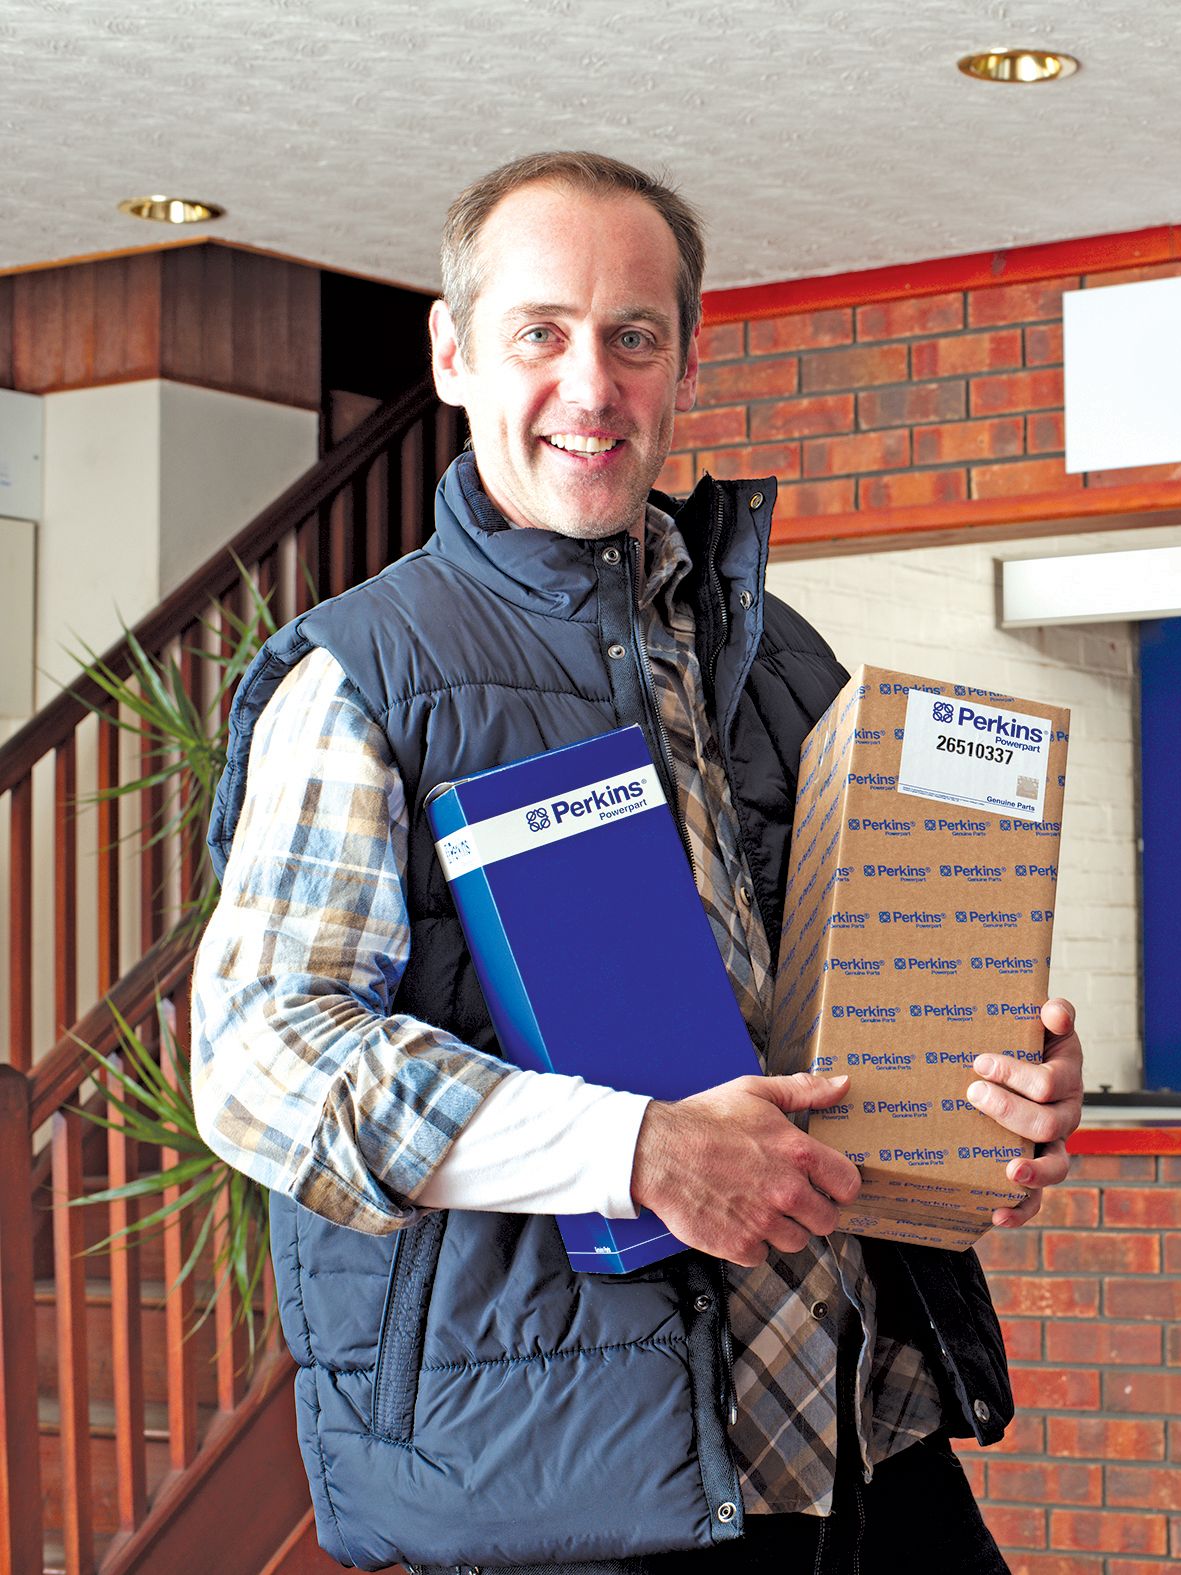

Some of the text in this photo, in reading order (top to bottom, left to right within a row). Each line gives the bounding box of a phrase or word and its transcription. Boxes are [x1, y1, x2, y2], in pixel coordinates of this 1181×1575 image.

[958, 706, 1043, 743] Perkins
[936, 735, 1013, 765] 26510337
[995, 736, 1041, 753] Powerpart
[848, 773, 895, 784] Perkins
[551, 781, 644, 824] Perkins
[986, 795, 1016, 808] Genuine
[1017, 802, 1036, 812] Parts
[598, 798, 648, 821] Powerpart
[862, 819, 911, 831] Perkins
[938, 819, 986, 831] Perkins
[878, 865, 927, 877] Perkins
[954, 864, 1002, 877] Perkins
[1029, 865, 1057, 877] Perk
[832, 912, 865, 923] rkins
[893, 911, 941, 923] Perkins
[969, 911, 1017, 923] Perkins
[831, 958, 880, 970] Perkins
[908, 957, 957, 969] Perkins
[985, 956, 1033, 969] Perkins
[847, 1005, 896, 1017] Perkins
[924, 1004, 973, 1016] Perkins
[1001, 1003, 1041, 1015] Perkin
[862, 1053, 911, 1065] Perkins
[878, 1100, 927, 1113] Perkins
[894, 1148, 944, 1161] Perkins
[972, 1145, 1021, 1158] Perkins
[984, 1189, 1026, 1201] Perkin
